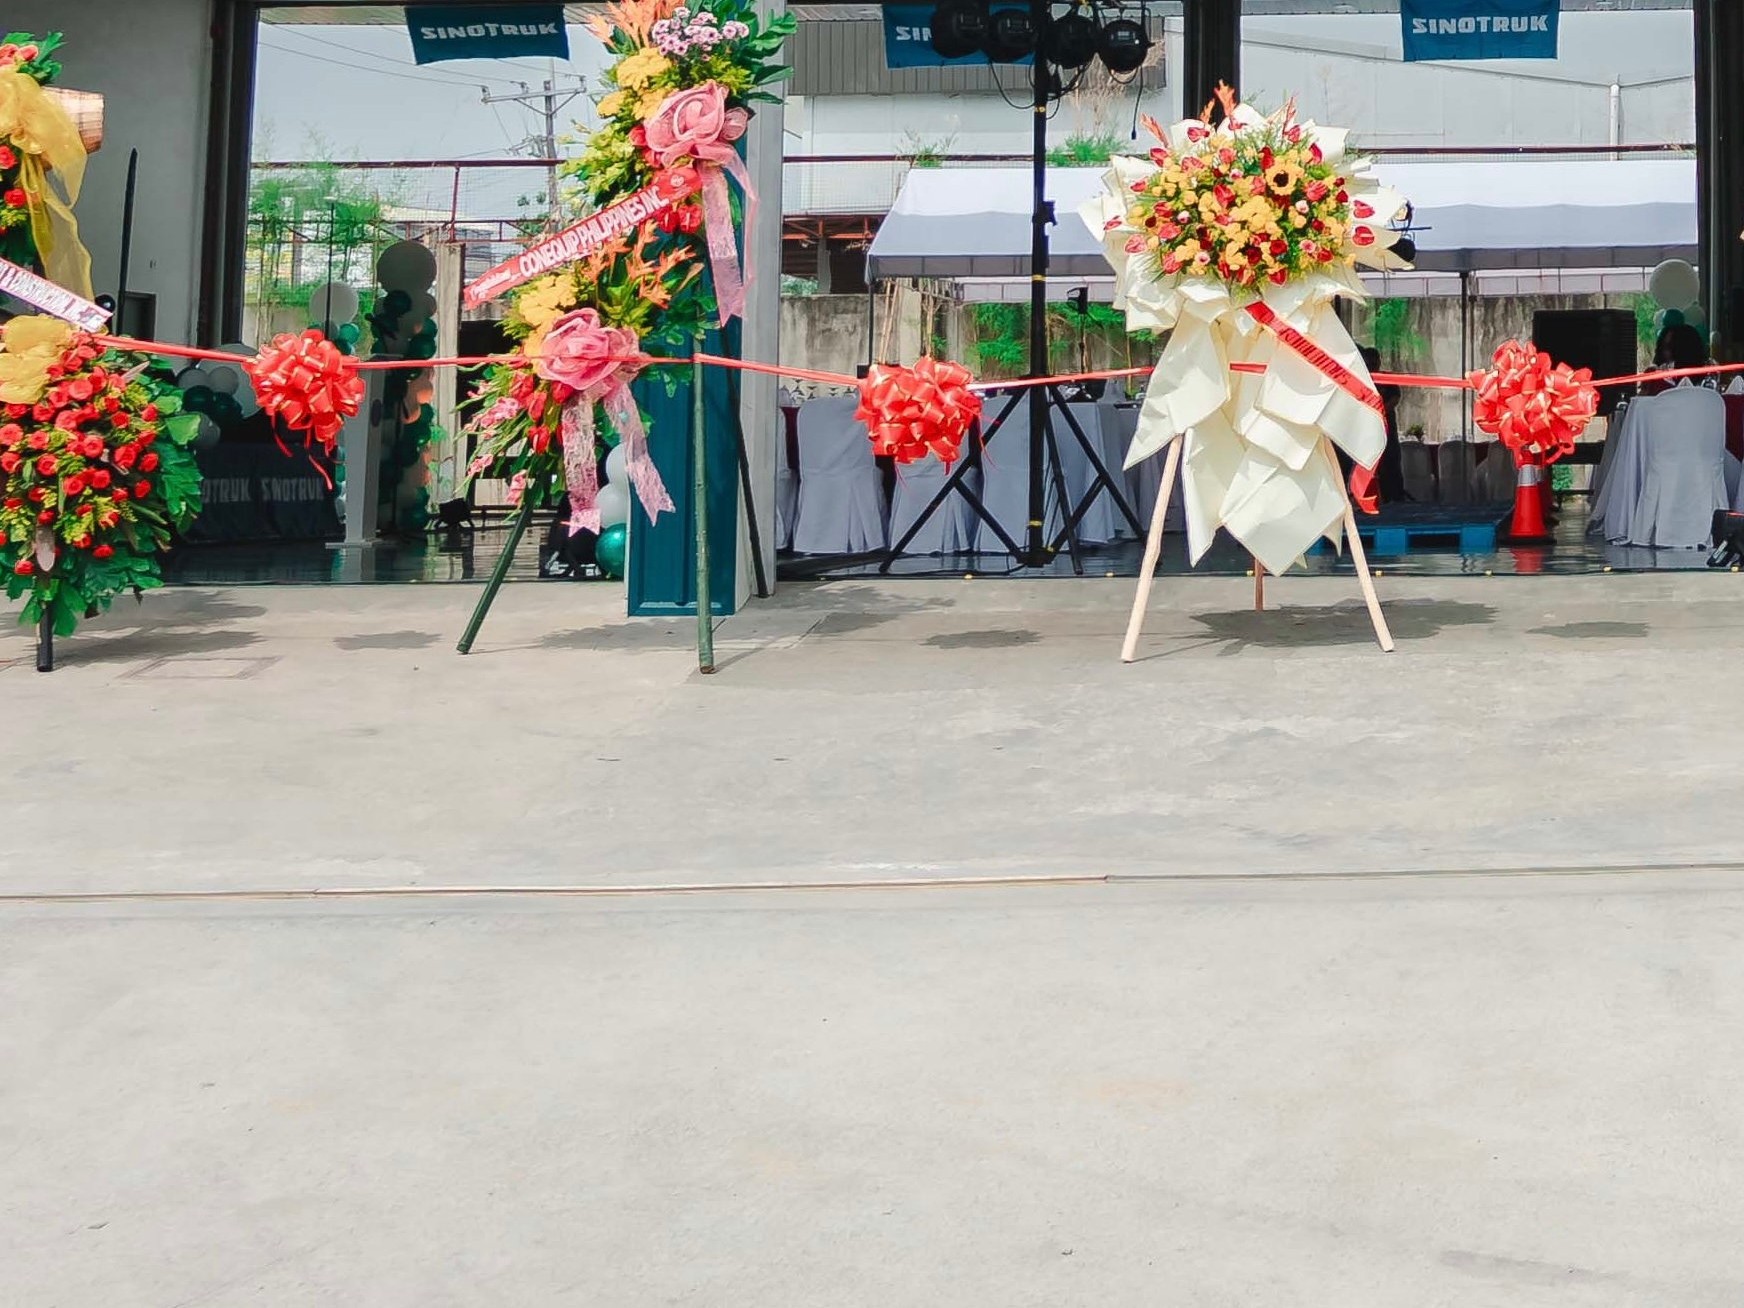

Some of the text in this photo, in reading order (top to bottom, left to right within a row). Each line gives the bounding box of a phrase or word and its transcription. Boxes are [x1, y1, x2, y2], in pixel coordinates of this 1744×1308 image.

[420, 23, 559, 39] SINOTRUK
[1412, 15, 1549, 34] SINOTRUK
[519, 228, 580, 277] CONEQUIP
[578, 199, 646, 249] PHILIPPINES
